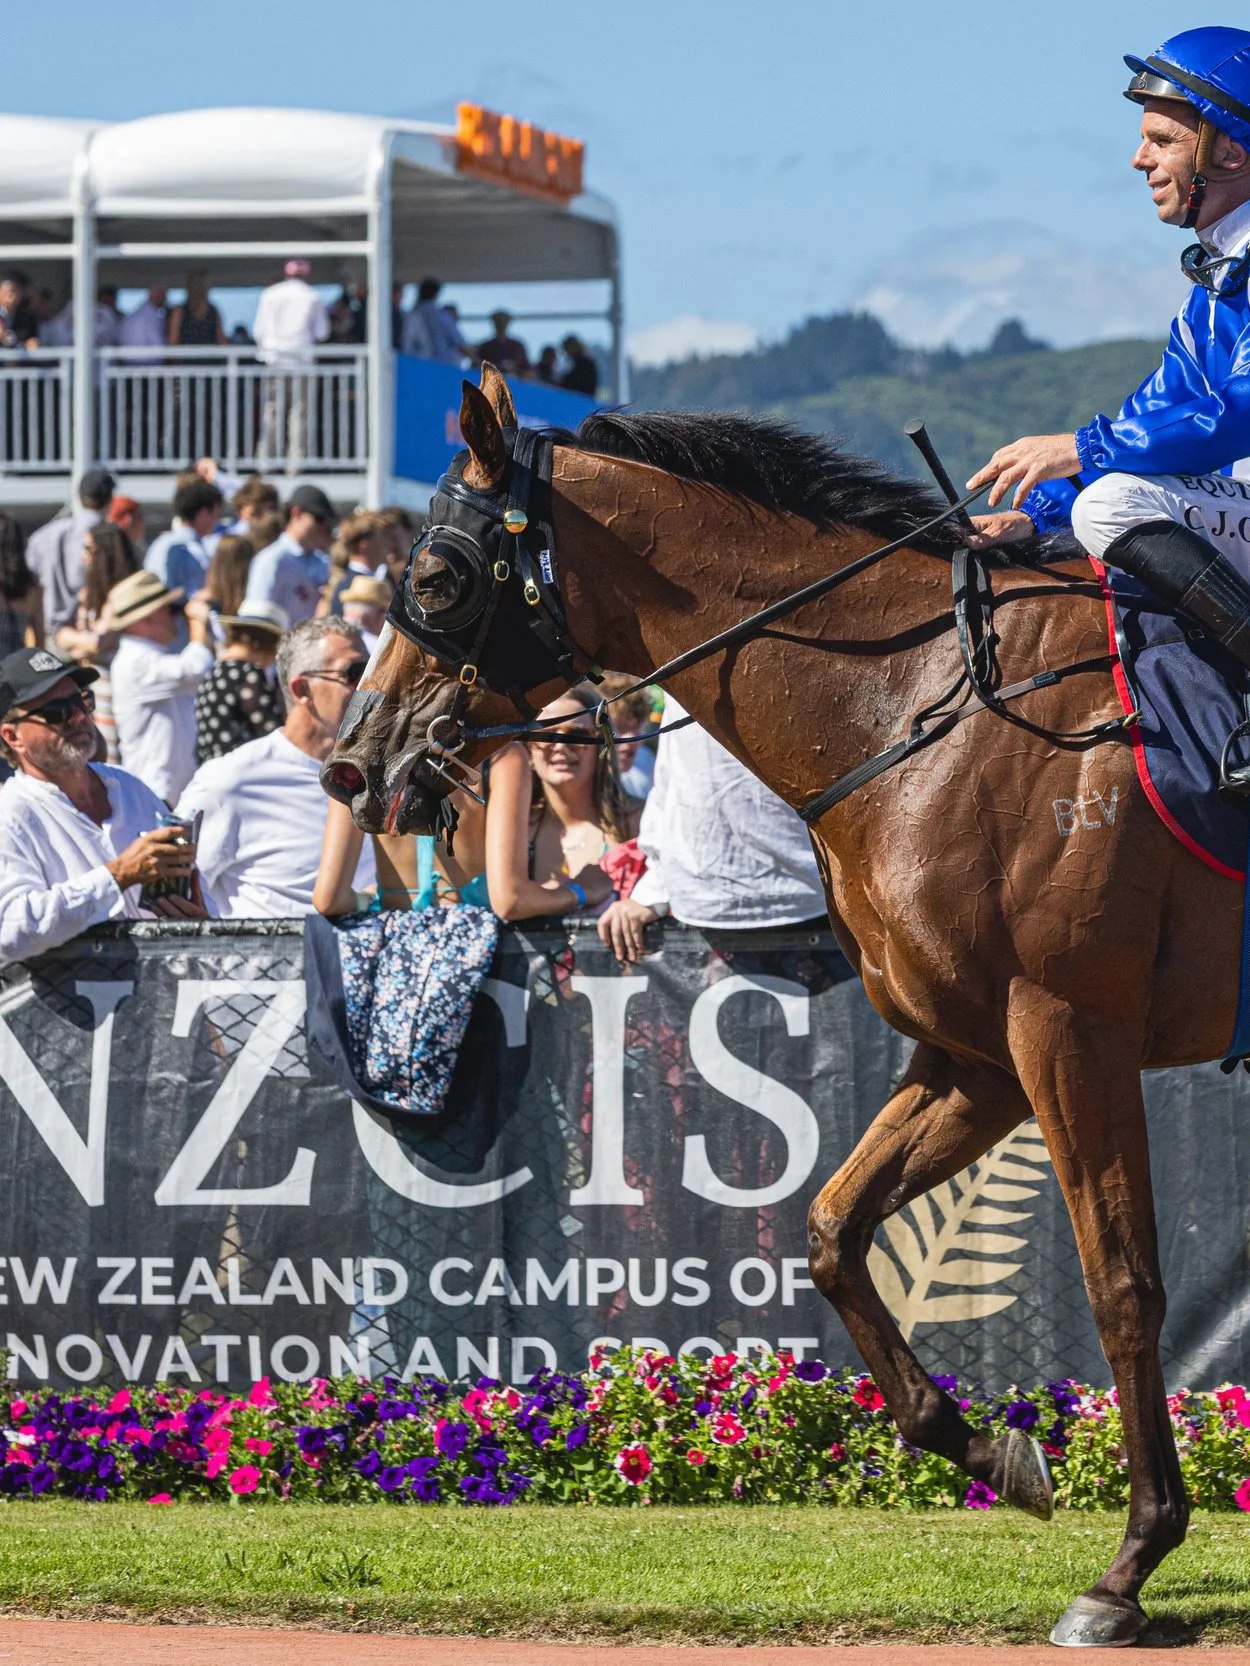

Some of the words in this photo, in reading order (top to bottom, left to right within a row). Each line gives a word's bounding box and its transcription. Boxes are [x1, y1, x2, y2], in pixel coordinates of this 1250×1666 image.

[0, 1256, 79, 1305] W
[96, 1256, 410, 1306] ZEALAND
[428, 1256, 712, 1307] CAMPUS
[728, 1256, 814, 1307] OF
[6, 1333, 372, 1383] NOVATION
[399, 1335, 558, 1385] AND
